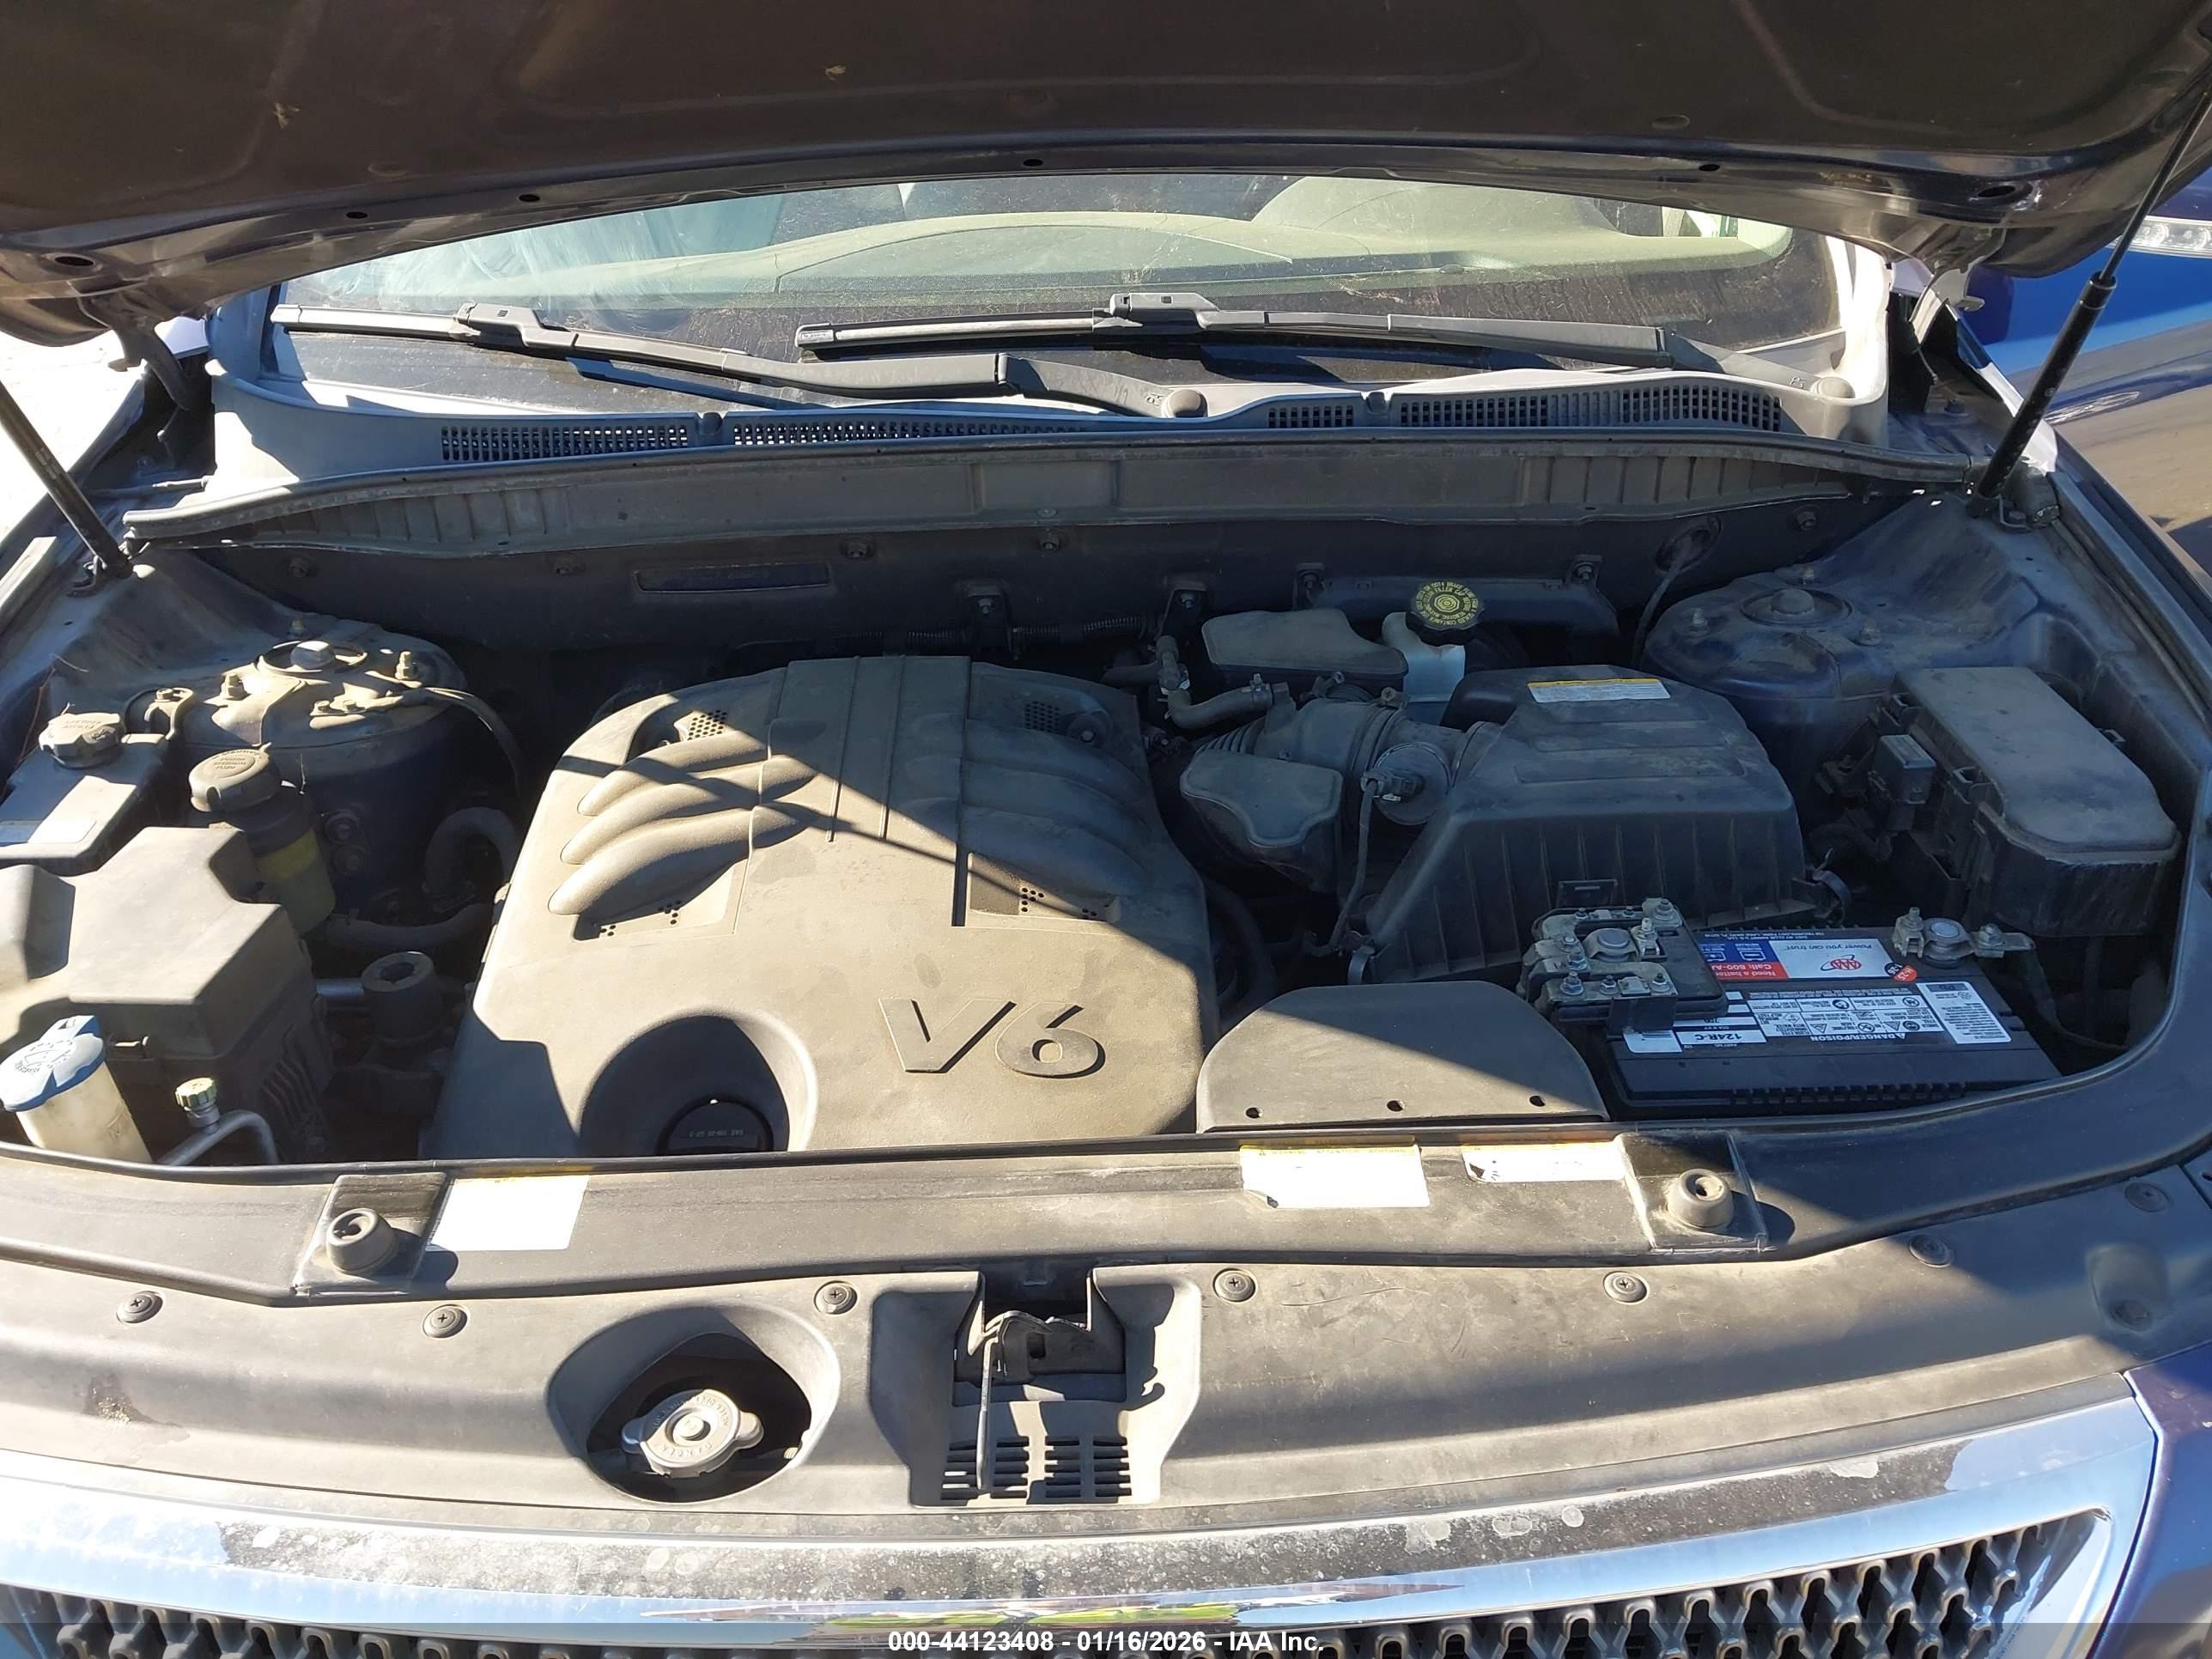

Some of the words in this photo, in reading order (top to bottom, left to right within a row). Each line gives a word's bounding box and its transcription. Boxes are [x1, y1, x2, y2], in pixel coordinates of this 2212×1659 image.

[1832, 959, 1859, 969] AAA
[877, 997, 1106, 1079] V6
[1810, 1033, 1896, 1042] DANGER/POISON
